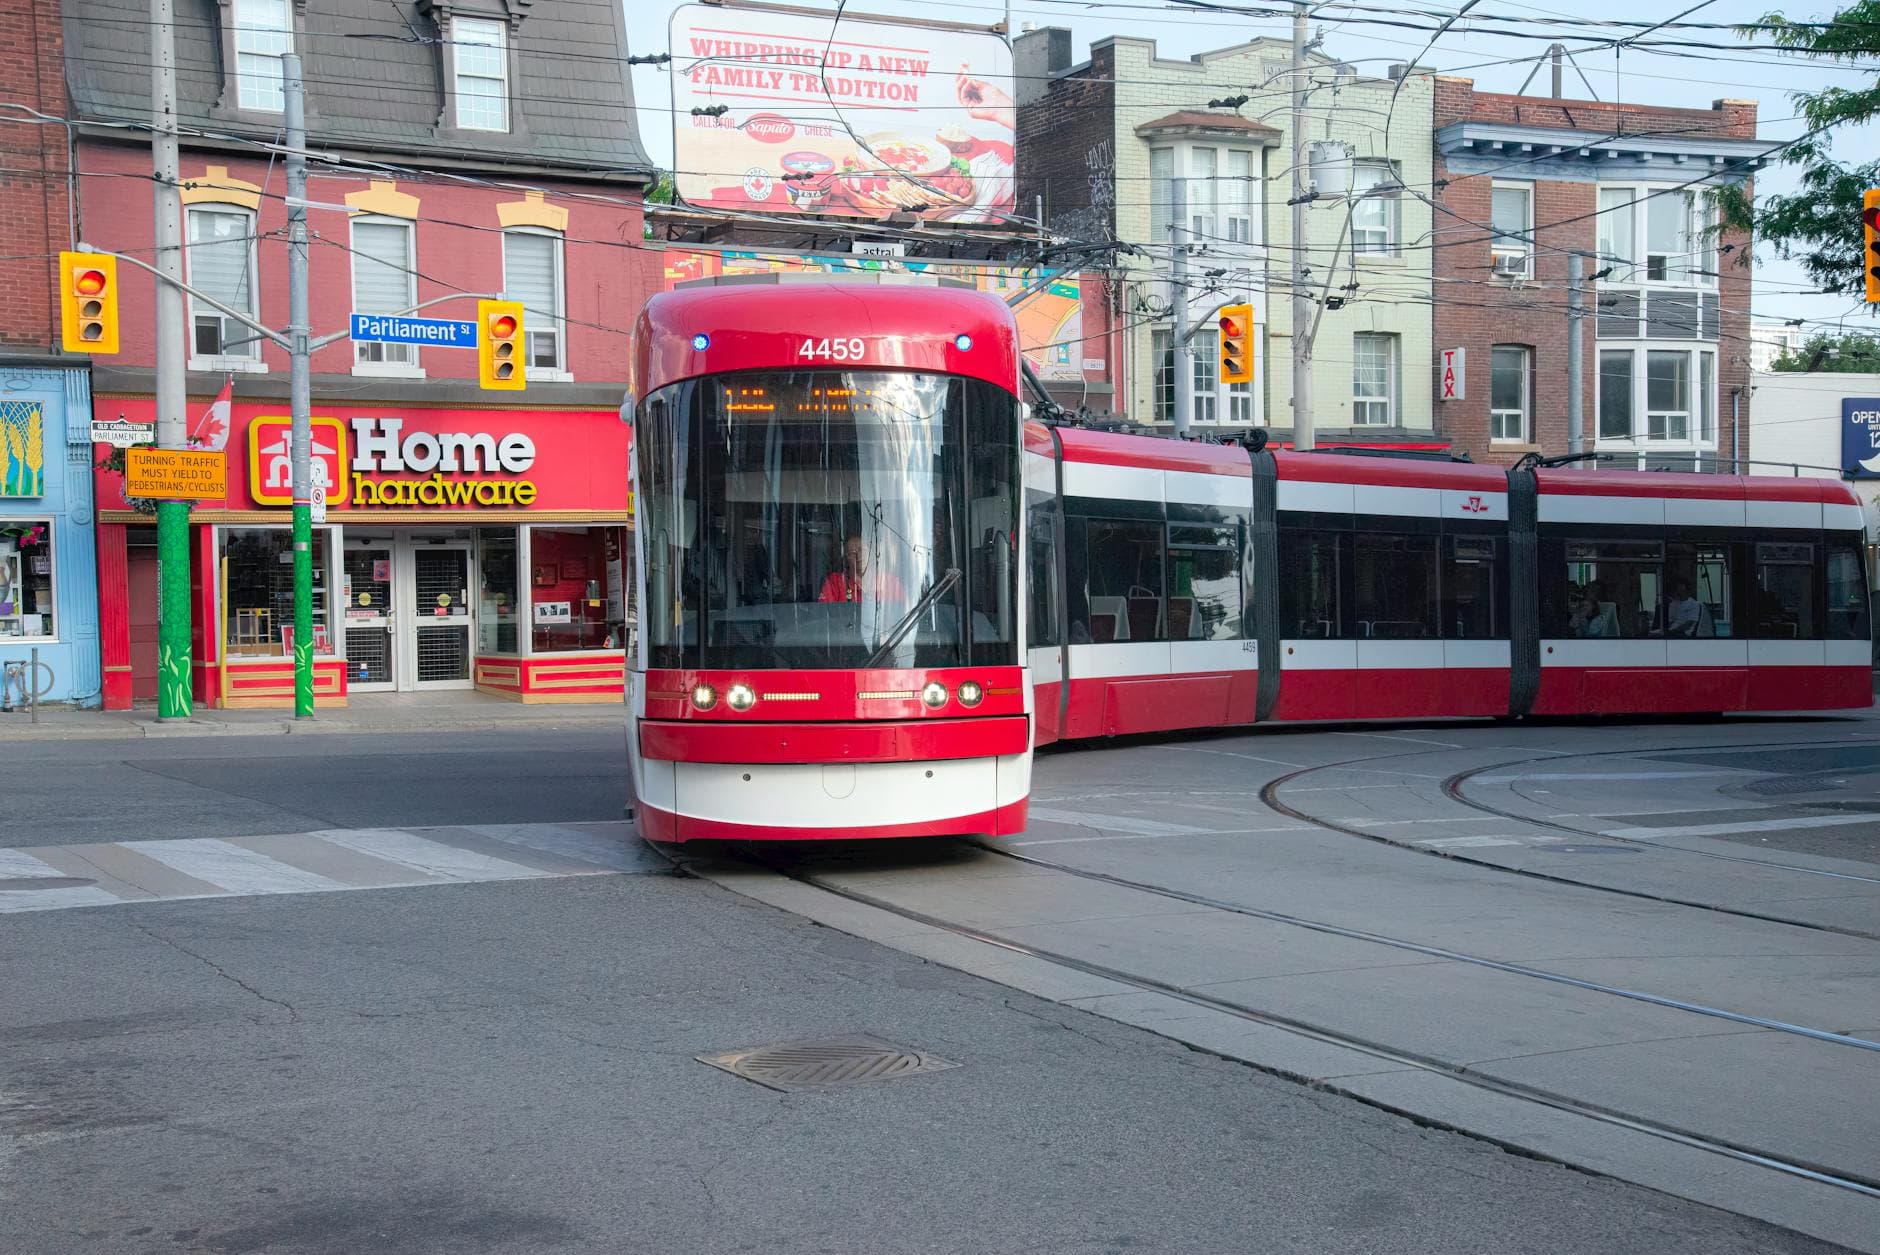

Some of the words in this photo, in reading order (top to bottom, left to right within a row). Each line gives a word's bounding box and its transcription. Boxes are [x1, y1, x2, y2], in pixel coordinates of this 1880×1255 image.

[690, 38, 815, 66] WHIPPING
[821, 50, 852, 69] UP
[858, 54, 873, 72] A
[879, 55, 929, 77] NEW
[691, 66, 783, 90] FAMILY
[789, 73, 918, 102] TRADITION
[804, 124, 832, 137] CHEESE
[358, 316, 456, 341] Parliament
[460, 324, 470, 335] St
[799, 338, 864, 360] 4459
[1444, 351, 1455, 397] TAX
[94, 432, 137, 441] PARLIAMENT
[141, 433, 149, 441] ST
[352, 418, 536, 472] Home
[133, 455, 176, 466] TURNING
[181, 456, 220, 467] TRAFFIC
[141, 469, 167, 478] MUST
[172, 470, 198, 479] YIELD
[200, 471, 212, 479] TO
[129, 480, 225, 493] PEDESTRIANS/CYCLISTS
[352, 472, 537, 505] hardware
